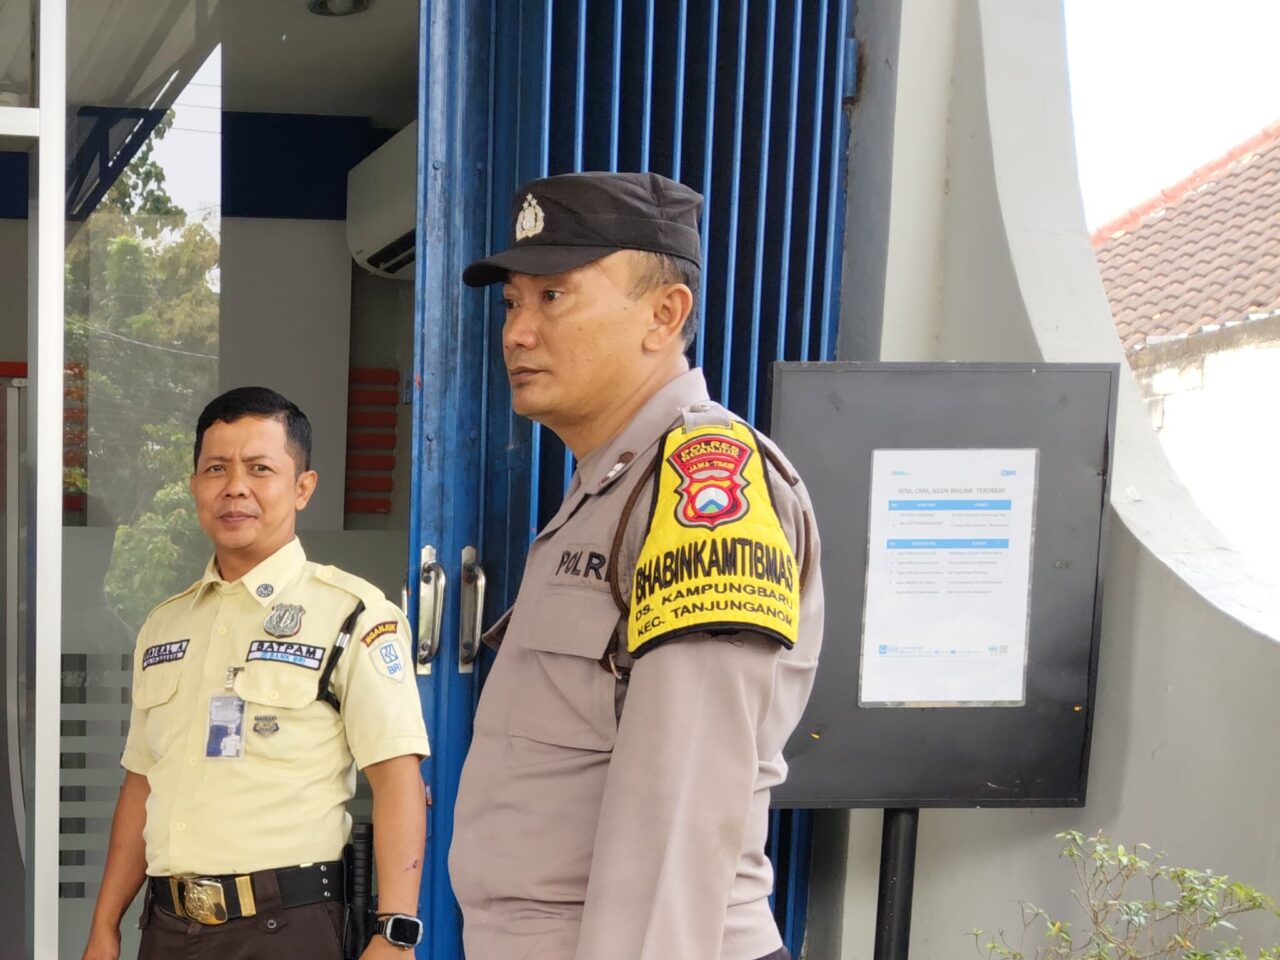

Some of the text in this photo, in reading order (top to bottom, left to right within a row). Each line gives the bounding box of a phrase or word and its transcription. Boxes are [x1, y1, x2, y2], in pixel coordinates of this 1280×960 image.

[635, 537, 794, 605] BHABINKAMTIBMAS
[635, 583, 793, 622] DS. KAMPUNGBARU
[637, 600, 793, 637] KEC. TANJUNGANOM
